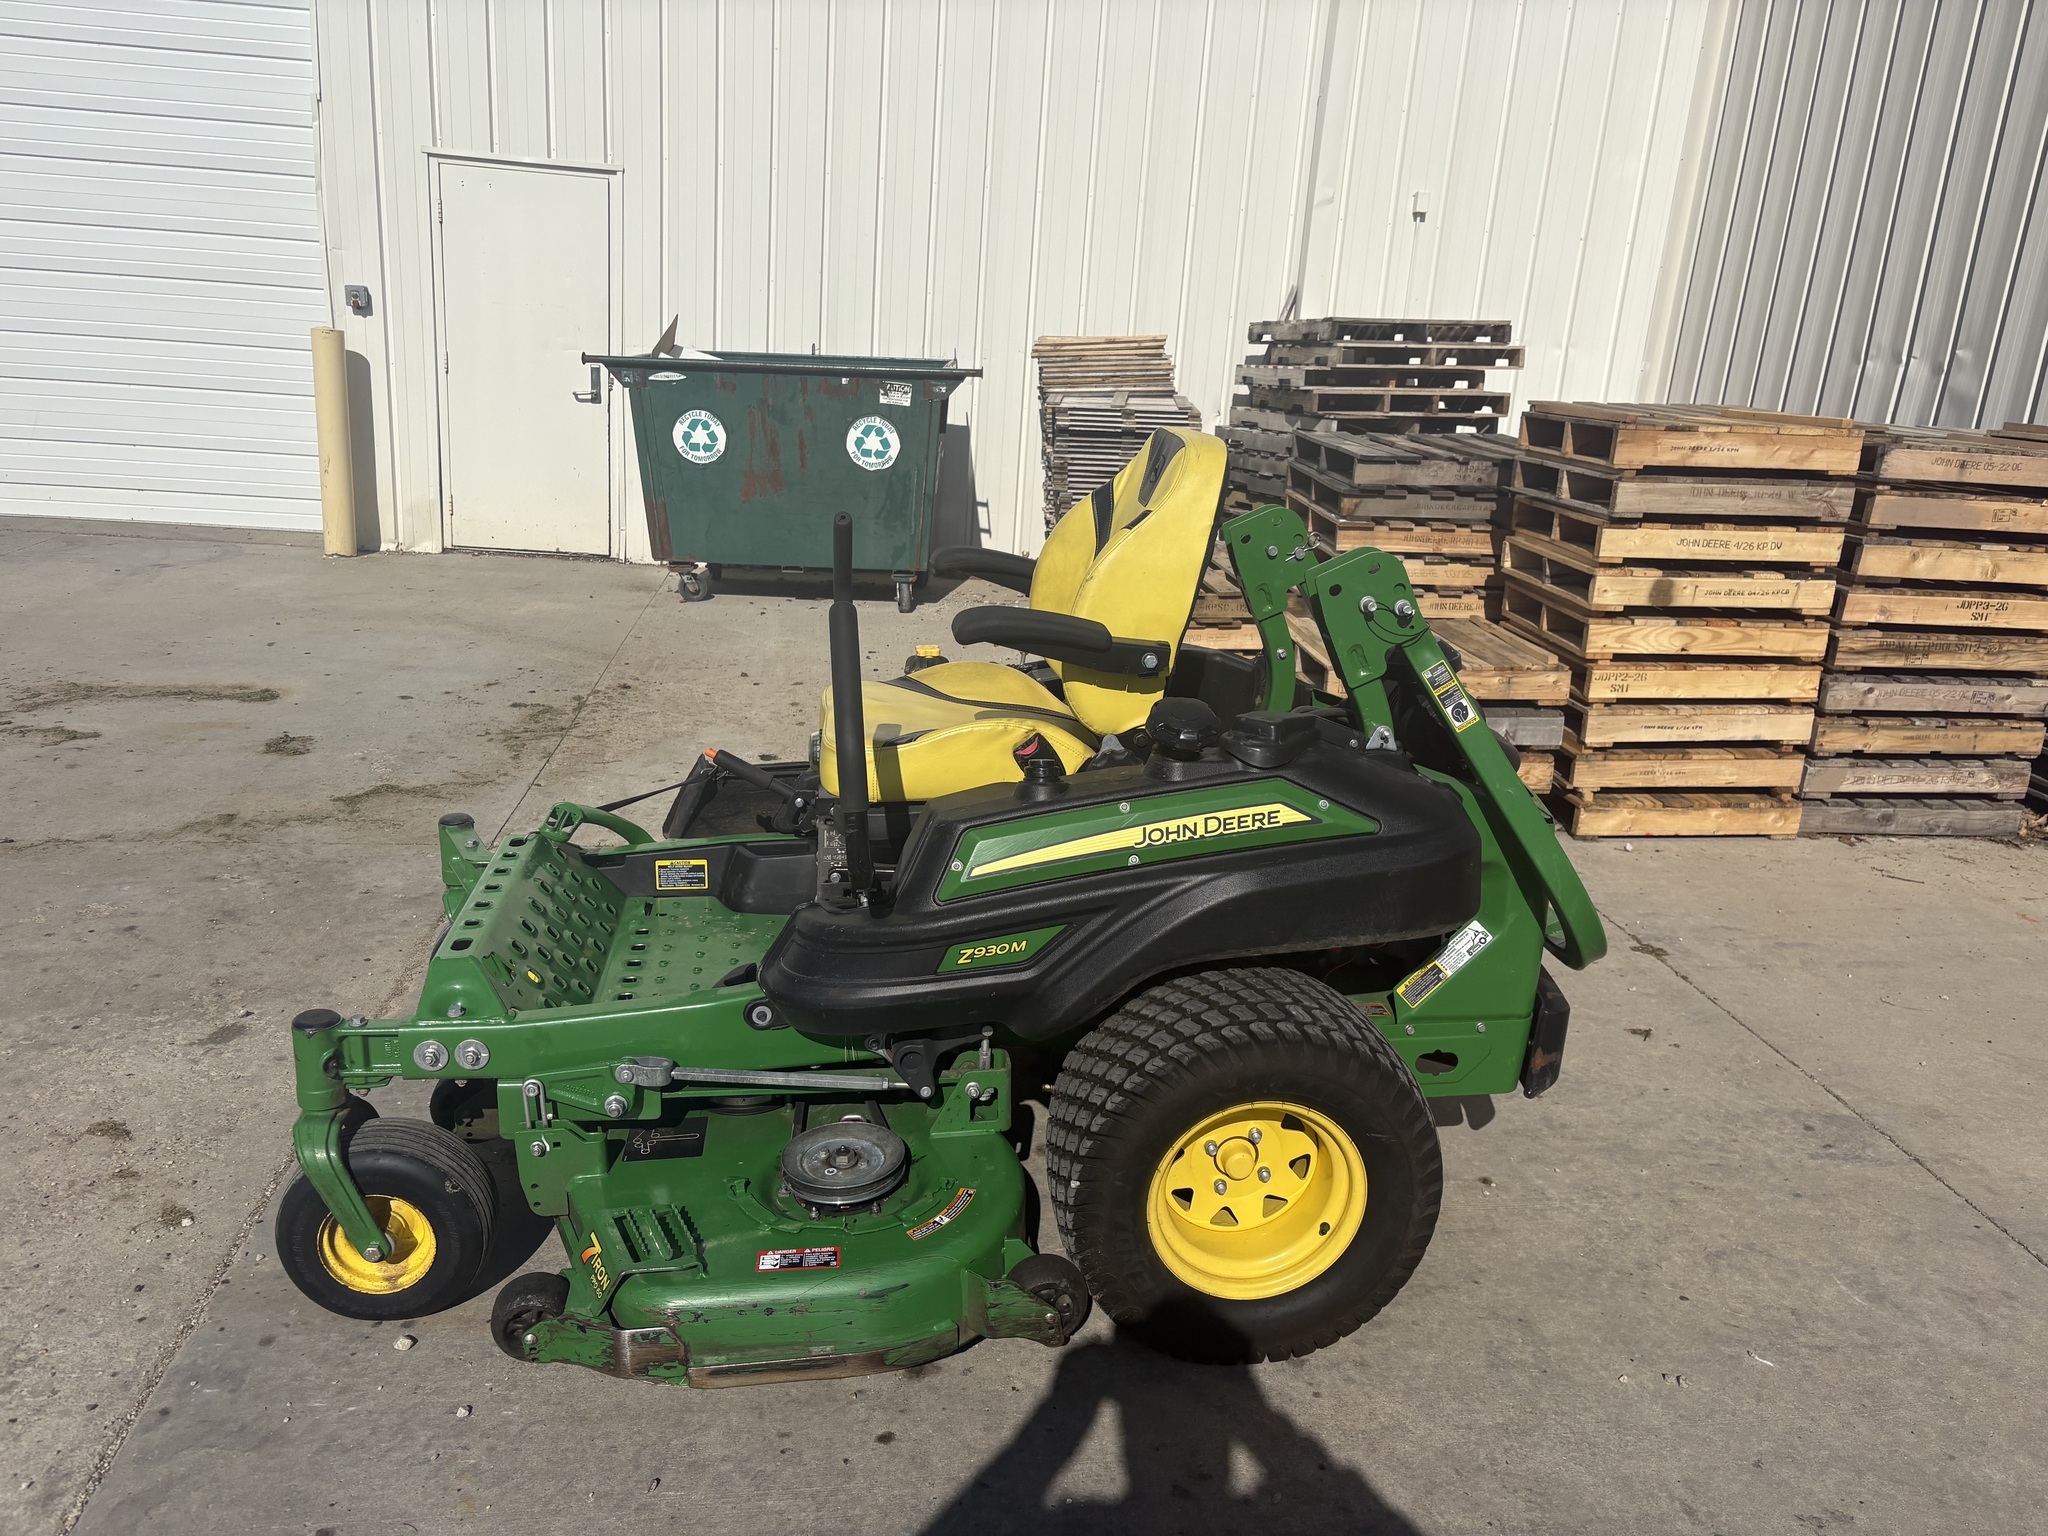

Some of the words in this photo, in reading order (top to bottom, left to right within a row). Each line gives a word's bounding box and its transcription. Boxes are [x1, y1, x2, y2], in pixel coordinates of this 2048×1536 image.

[679, 411, 702, 426] RECYCLE
[704, 412, 721, 427] TODAY
[852, 417, 877, 431] RECYCLE
[878, 420, 895, 435] TODAY
[679, 445, 690, 457] FOR
[690, 448, 722, 462] TOMORROW
[851, 451, 861, 463] FOR
[861, 454, 894, 469] TOMORROW
[1931, 457, 1954, 468] JOHN
[1954, 459, 1982, 471] DEERE
[1983, 461, 2010, 472] 05-22
[1676, 538, 1700, 548] JOHN
[1702, 539, 1731, 550] DEERE
[1733, 541, 1754, 551] 4/26
[1723, 589, 1745, 597] DEERE
[1449, 602, 1474, 611] DEERE
[1956, 600, 2009, 611] JDPP3-26
[1594, 672, 1648, 682] JDPP2-26
[1876, 688, 1898, 698] JOHN
[1899, 687, 1929, 697] DEERE
[1134, 822, 1197, 846] JOHN
[1204, 810, 1281, 835] DEERE
[957, 940, 1027, 965] Z930M
